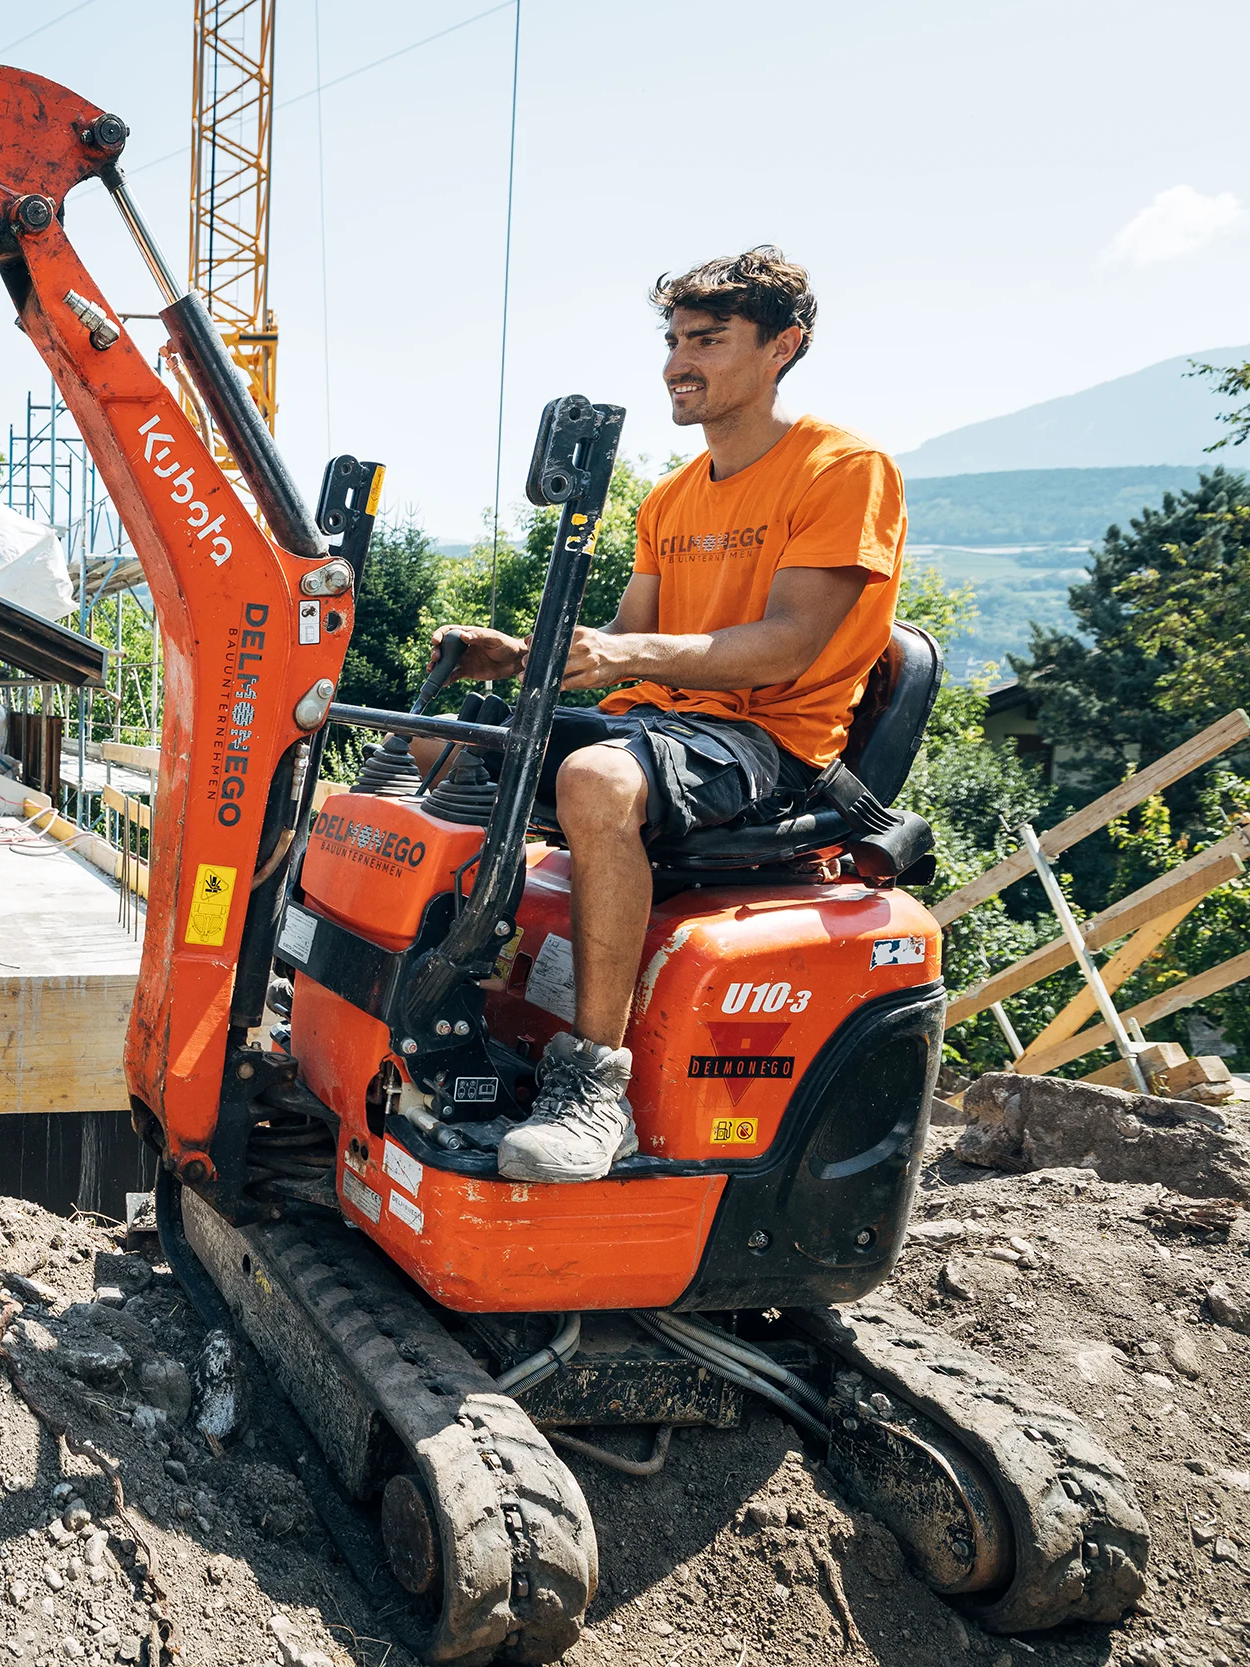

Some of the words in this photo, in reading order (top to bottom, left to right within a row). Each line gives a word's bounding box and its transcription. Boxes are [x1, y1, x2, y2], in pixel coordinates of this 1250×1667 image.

[138, 414, 233, 567] Kubota
[668, 550, 753, 564] BUNTERNEMEN
[207, 627, 238, 800] BAUUNTERNEHMEN
[218, 603, 269, 827] DELMONEGO
[314, 812, 426, 868] DELMONEGO
[320, 841, 404, 878] BAUUNTERNEHMEN
[721, 982, 812, 1014] U10-3
[691, 1060, 791, 1075] DELMONEGO
